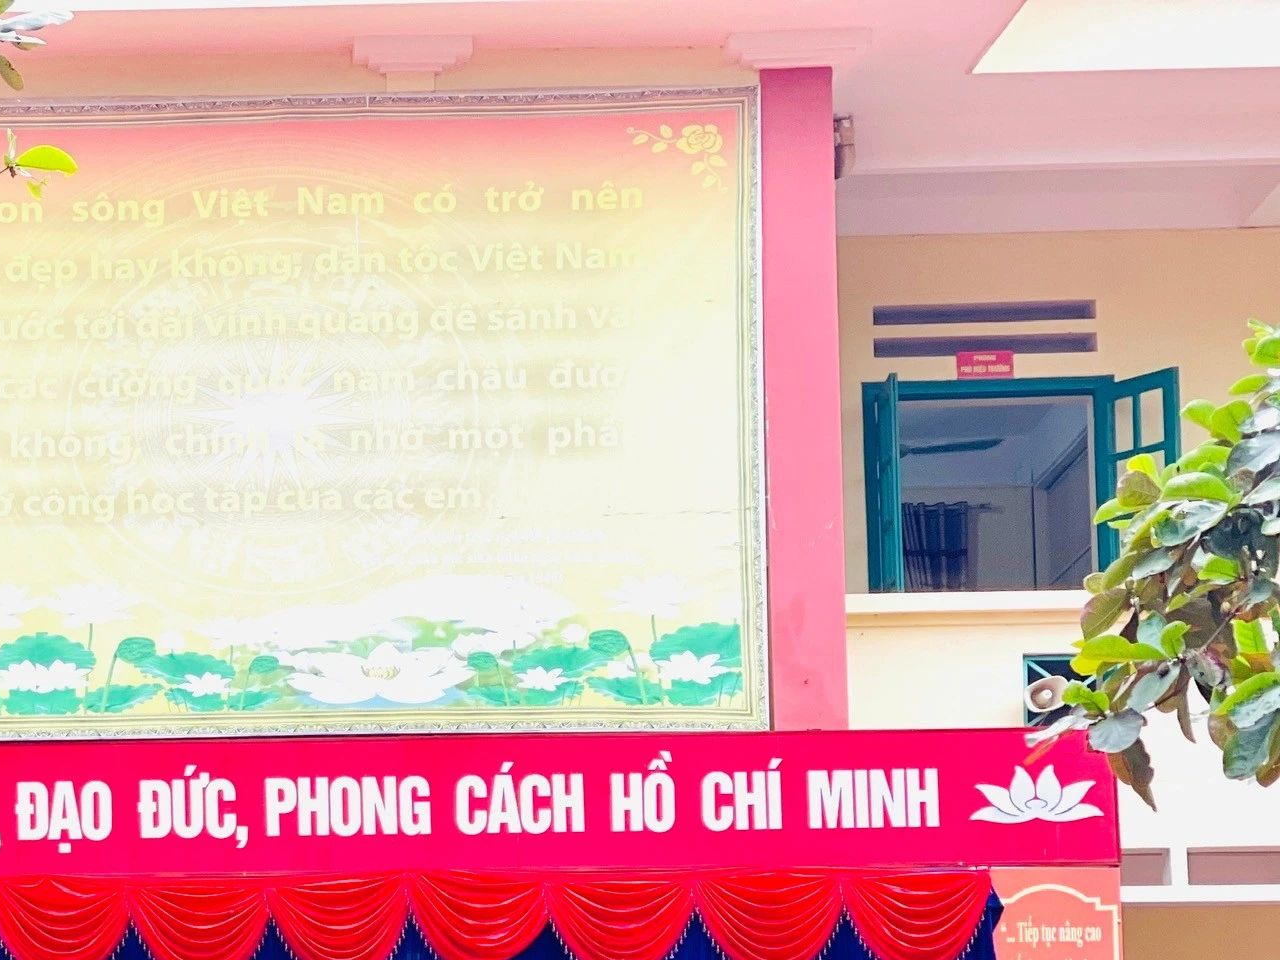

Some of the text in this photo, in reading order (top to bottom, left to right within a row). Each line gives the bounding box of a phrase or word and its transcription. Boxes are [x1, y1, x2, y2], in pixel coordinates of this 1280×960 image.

[72, 191, 166, 228] sông
[192, 187, 269, 227] Việt
[296, 185, 386, 216] Nam
[413, 181, 458, 214] có
[484, 180, 545, 213] trở
[571, 180, 644, 212] nên
[90, 250, 159, 285] hay
[469, 240, 543, 280] Việt
[15, 779, 112, 854] ĐẠO
[138, 763, 249, 848] ĐỨC,
[265, 774, 432, 839] PHONG
[455, 760, 585, 836] CÁCH
[610, 750, 675, 833] HỒ
[701, 757, 784, 831] CHÍ
[807, 766, 939, 829] MINH
[1016, 915, 1103, 949] Tiếp tục nâng cao
